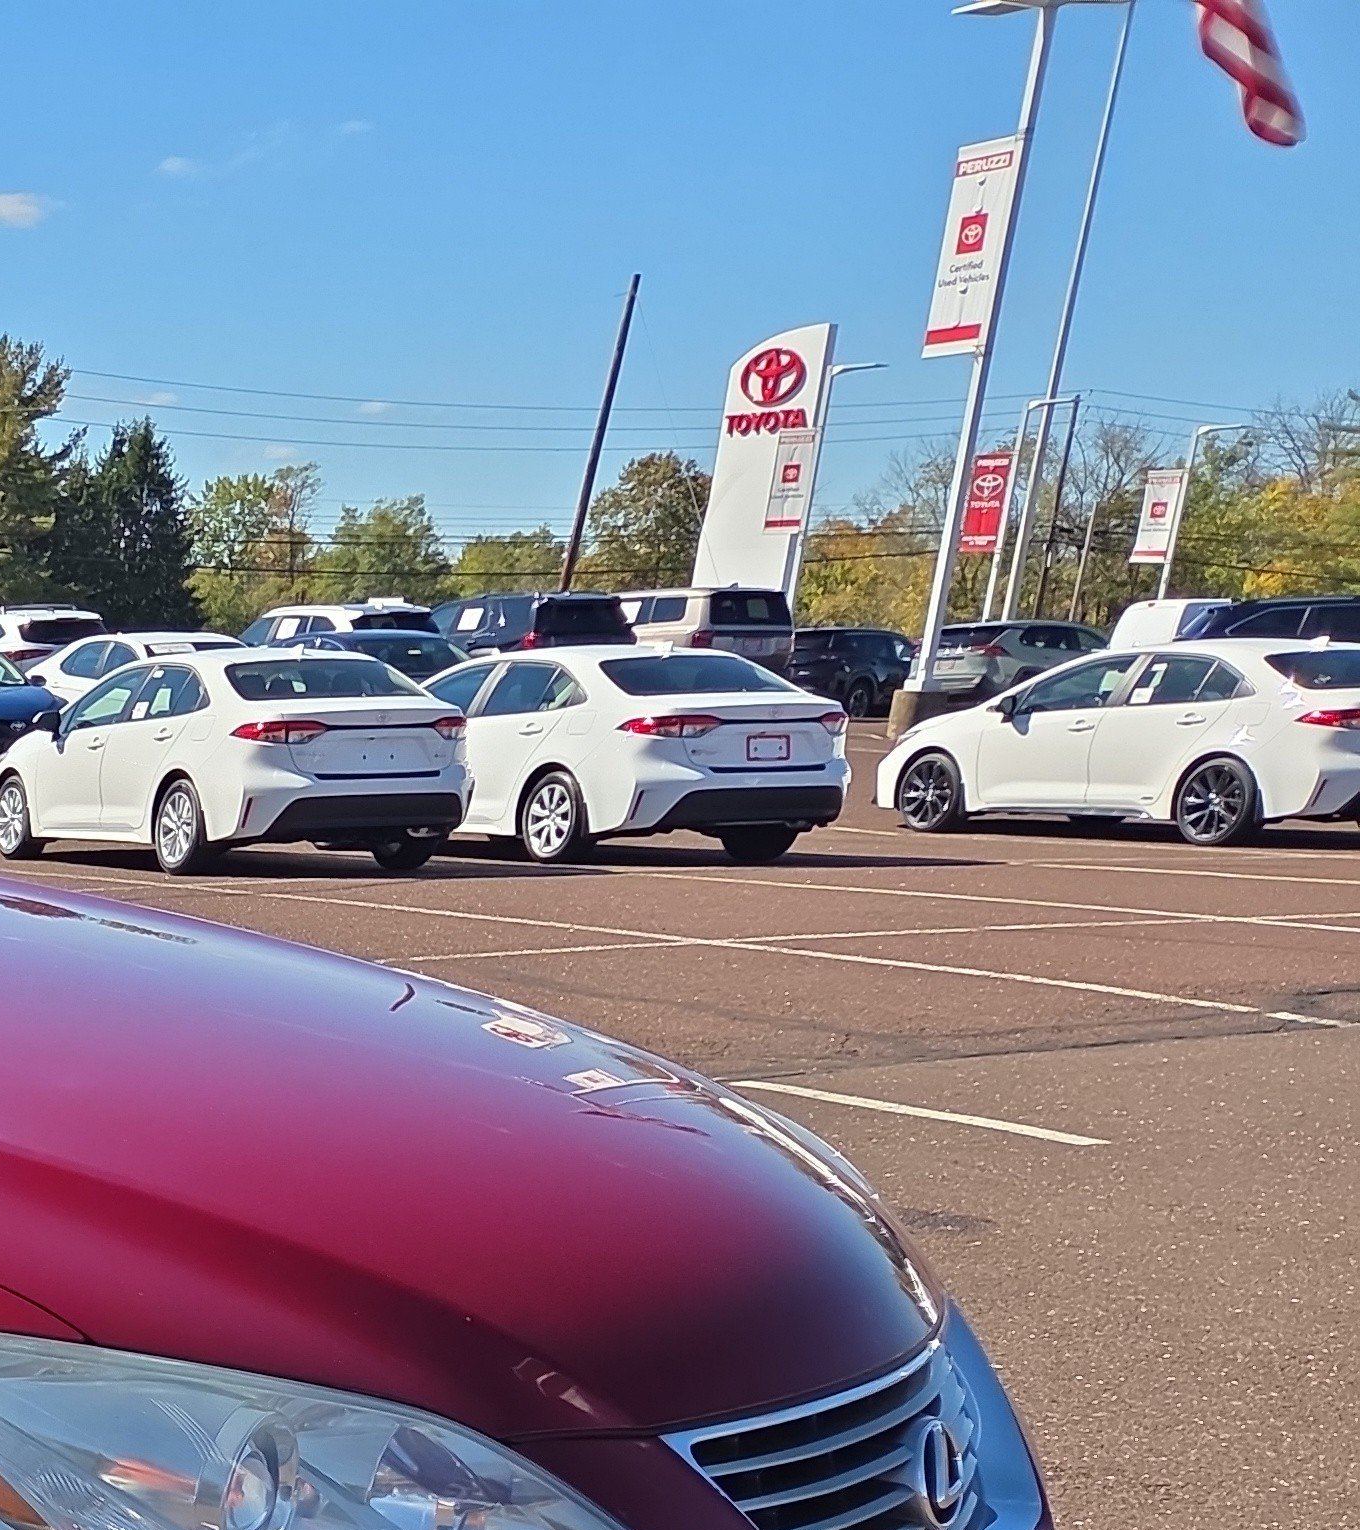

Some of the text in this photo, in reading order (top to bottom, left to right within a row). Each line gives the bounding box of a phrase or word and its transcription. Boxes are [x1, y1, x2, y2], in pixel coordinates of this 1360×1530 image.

[958, 153, 1010, 175] PERUZZI
[949, 259, 984, 273] Certified
[938, 276, 957, 288] Used
[725, 408, 808, 437] TOYOTA
